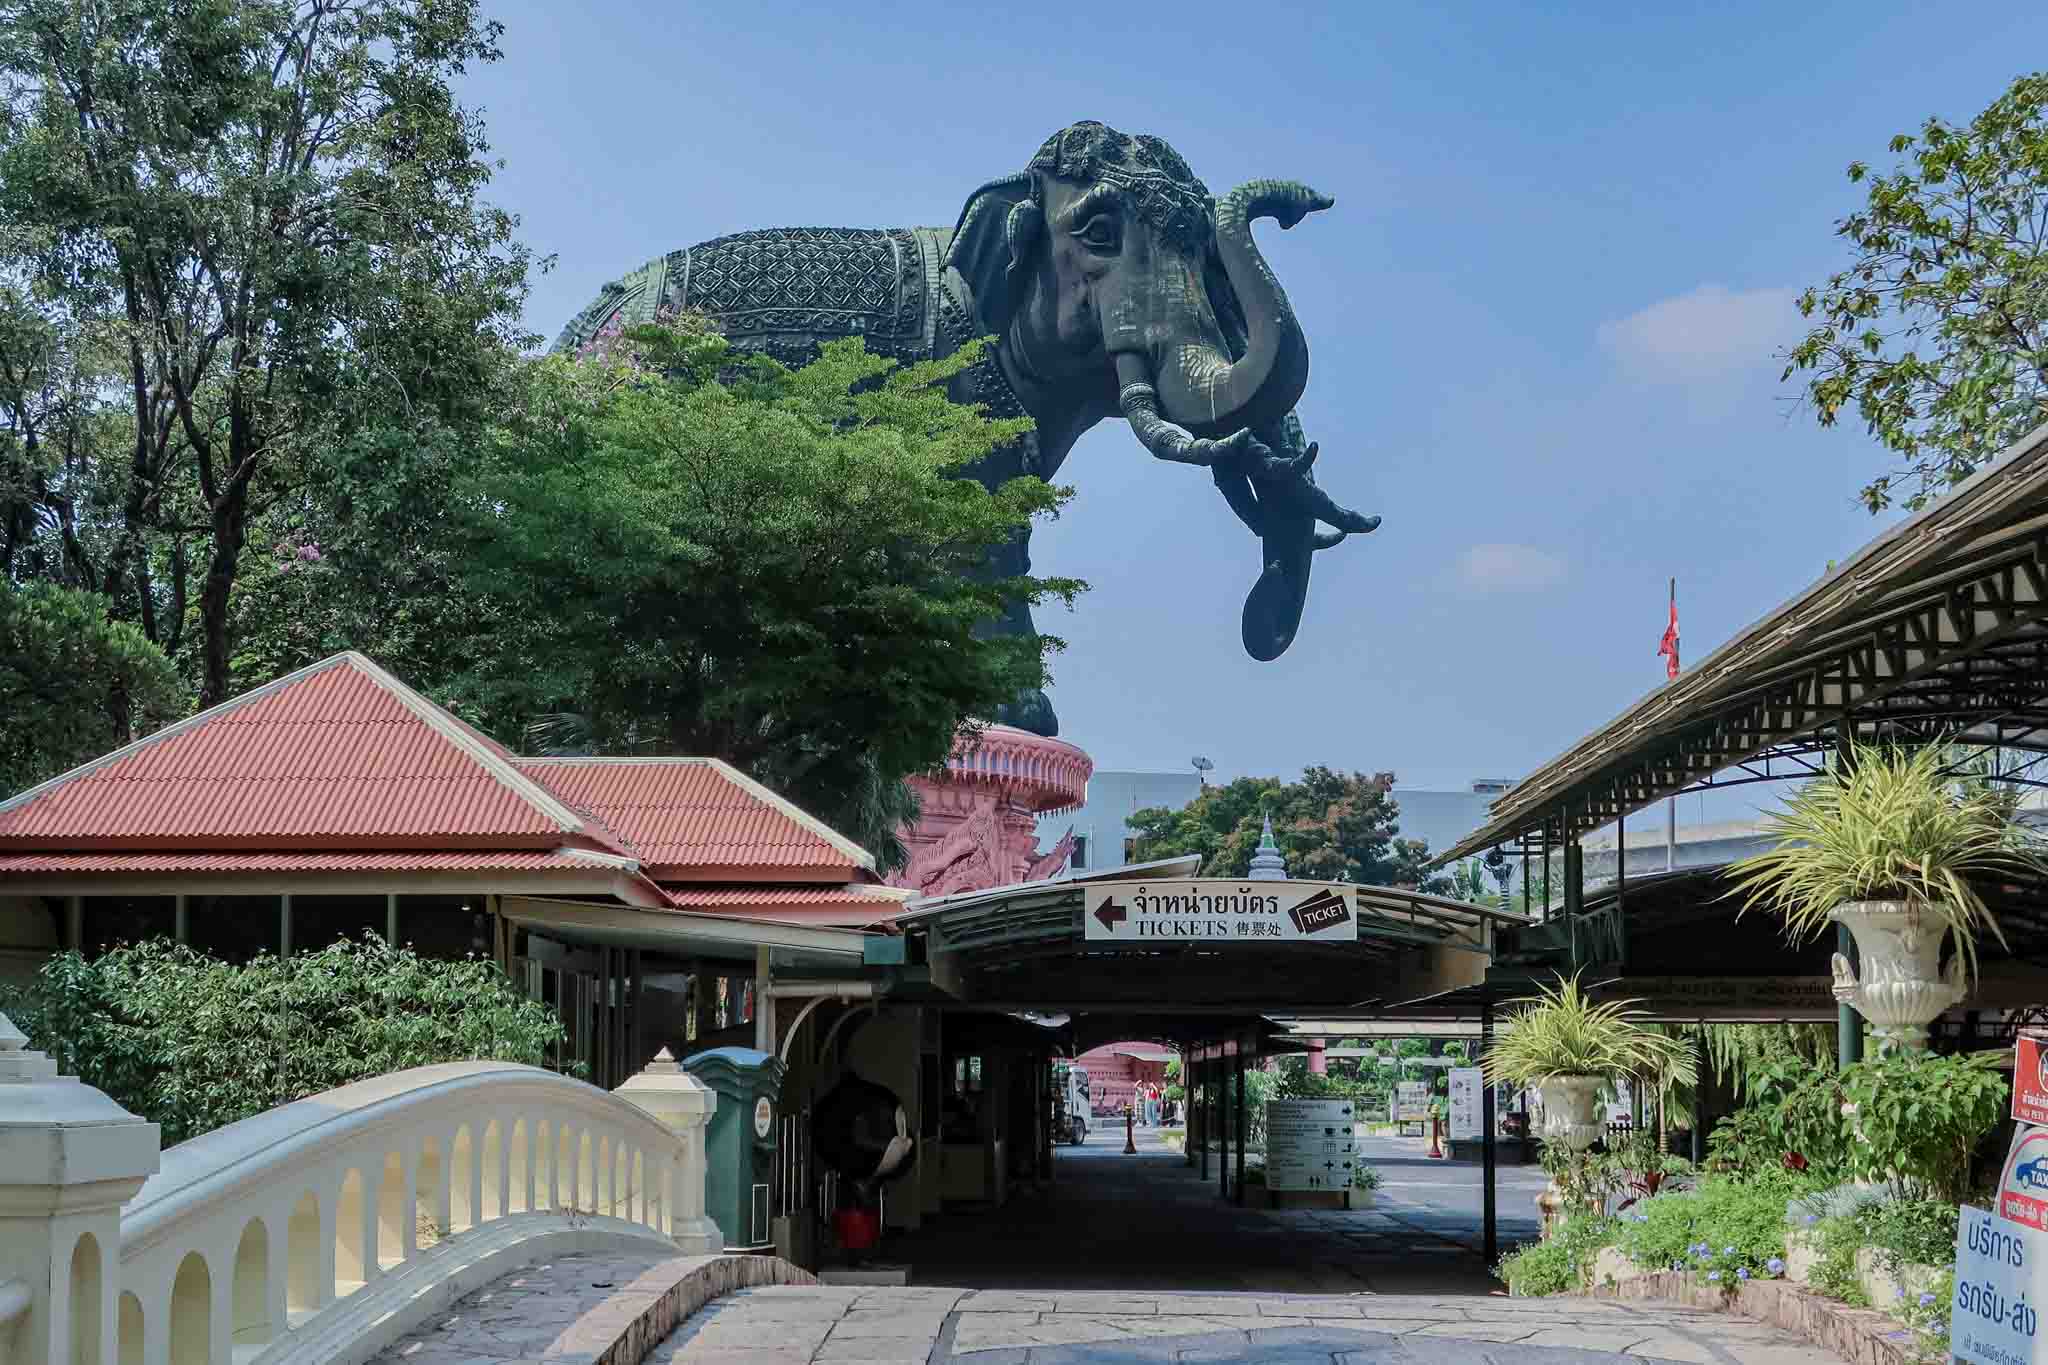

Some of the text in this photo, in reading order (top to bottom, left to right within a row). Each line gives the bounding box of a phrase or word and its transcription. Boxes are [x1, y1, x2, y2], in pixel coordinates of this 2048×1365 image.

[1133, 886, 1280, 915] จำหน่ายบัตร
[1303, 903, 1345, 926] TICKET
[1136, 920, 1228, 937] TICKETS
[1235, 920, 1282, 938] 售票处
[1968, 1215, 2024, 1268] บริการ
[1958, 1280, 2037, 1337] รถรับ-ส่ง
